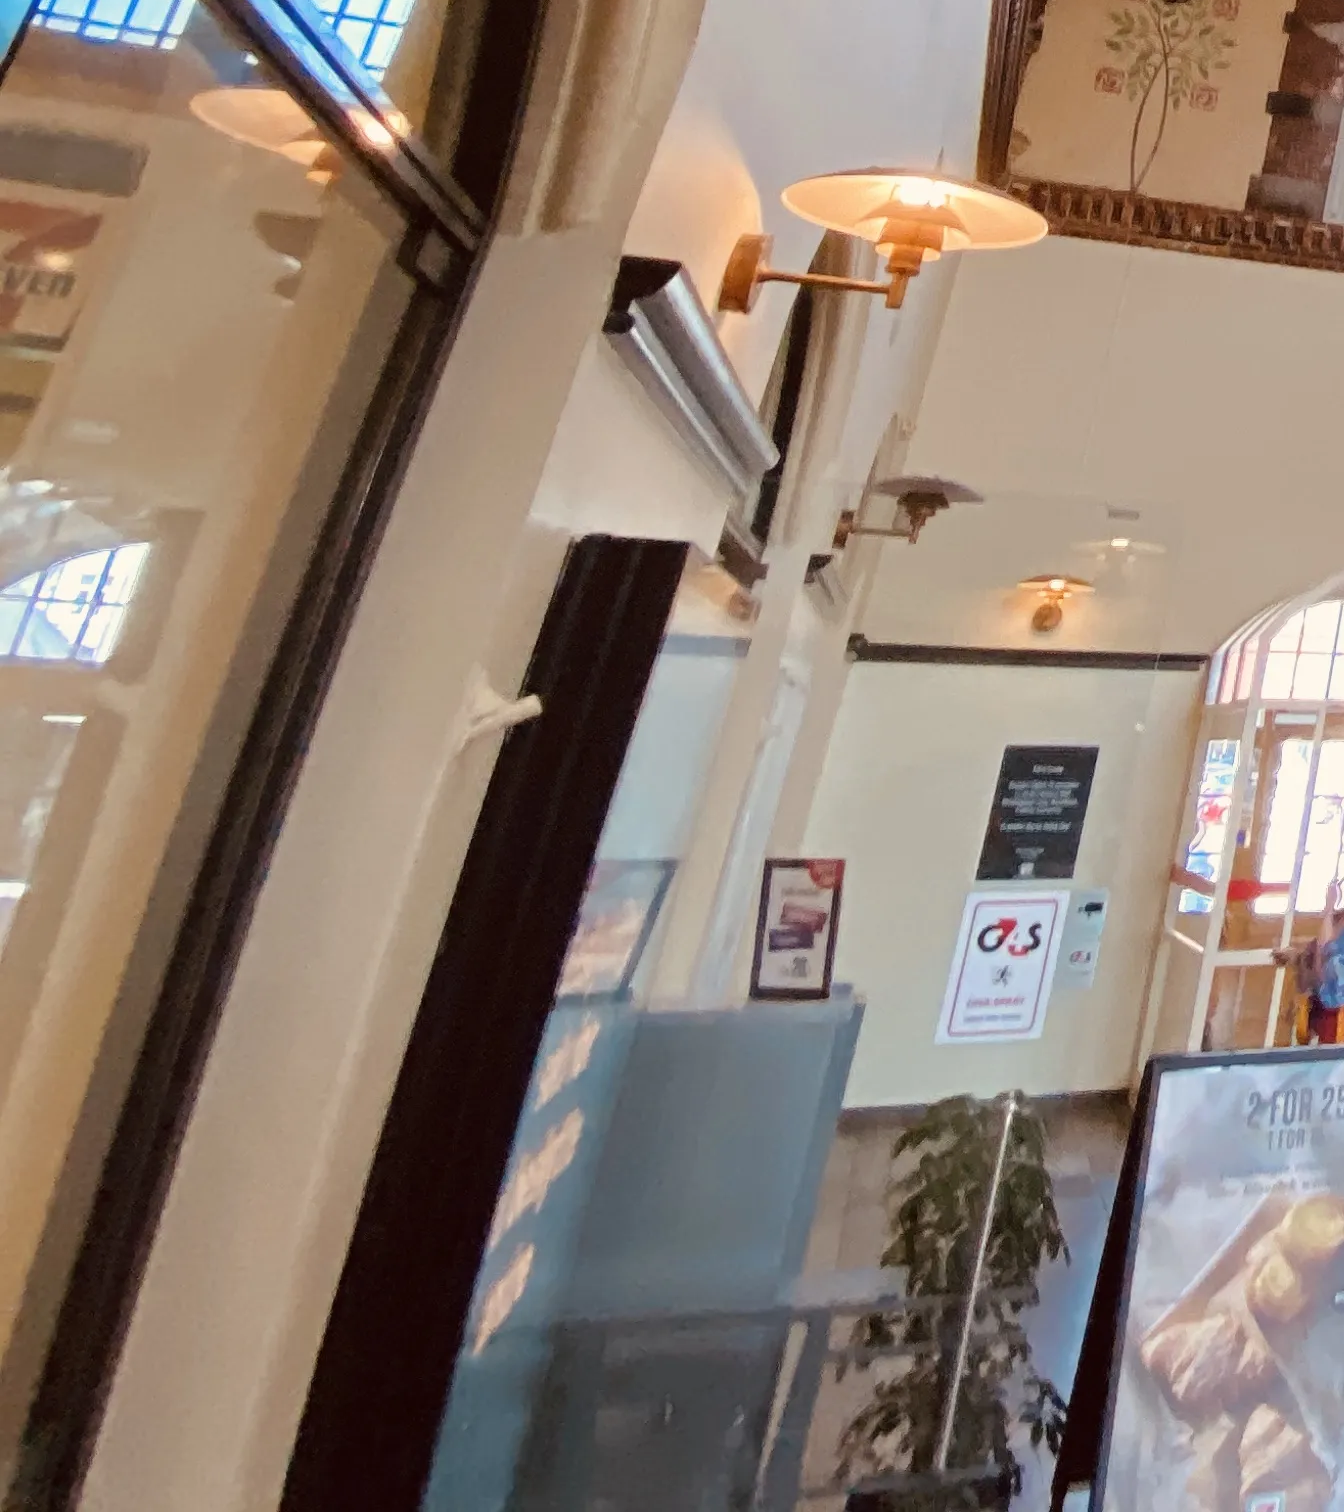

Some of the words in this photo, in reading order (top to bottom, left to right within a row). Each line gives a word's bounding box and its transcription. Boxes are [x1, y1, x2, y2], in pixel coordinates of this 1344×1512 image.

[977, 917, 1042, 957] G4S
[1247, 1091, 1261, 1129] 2
[1269, 1088, 1313, 1127] FOR
